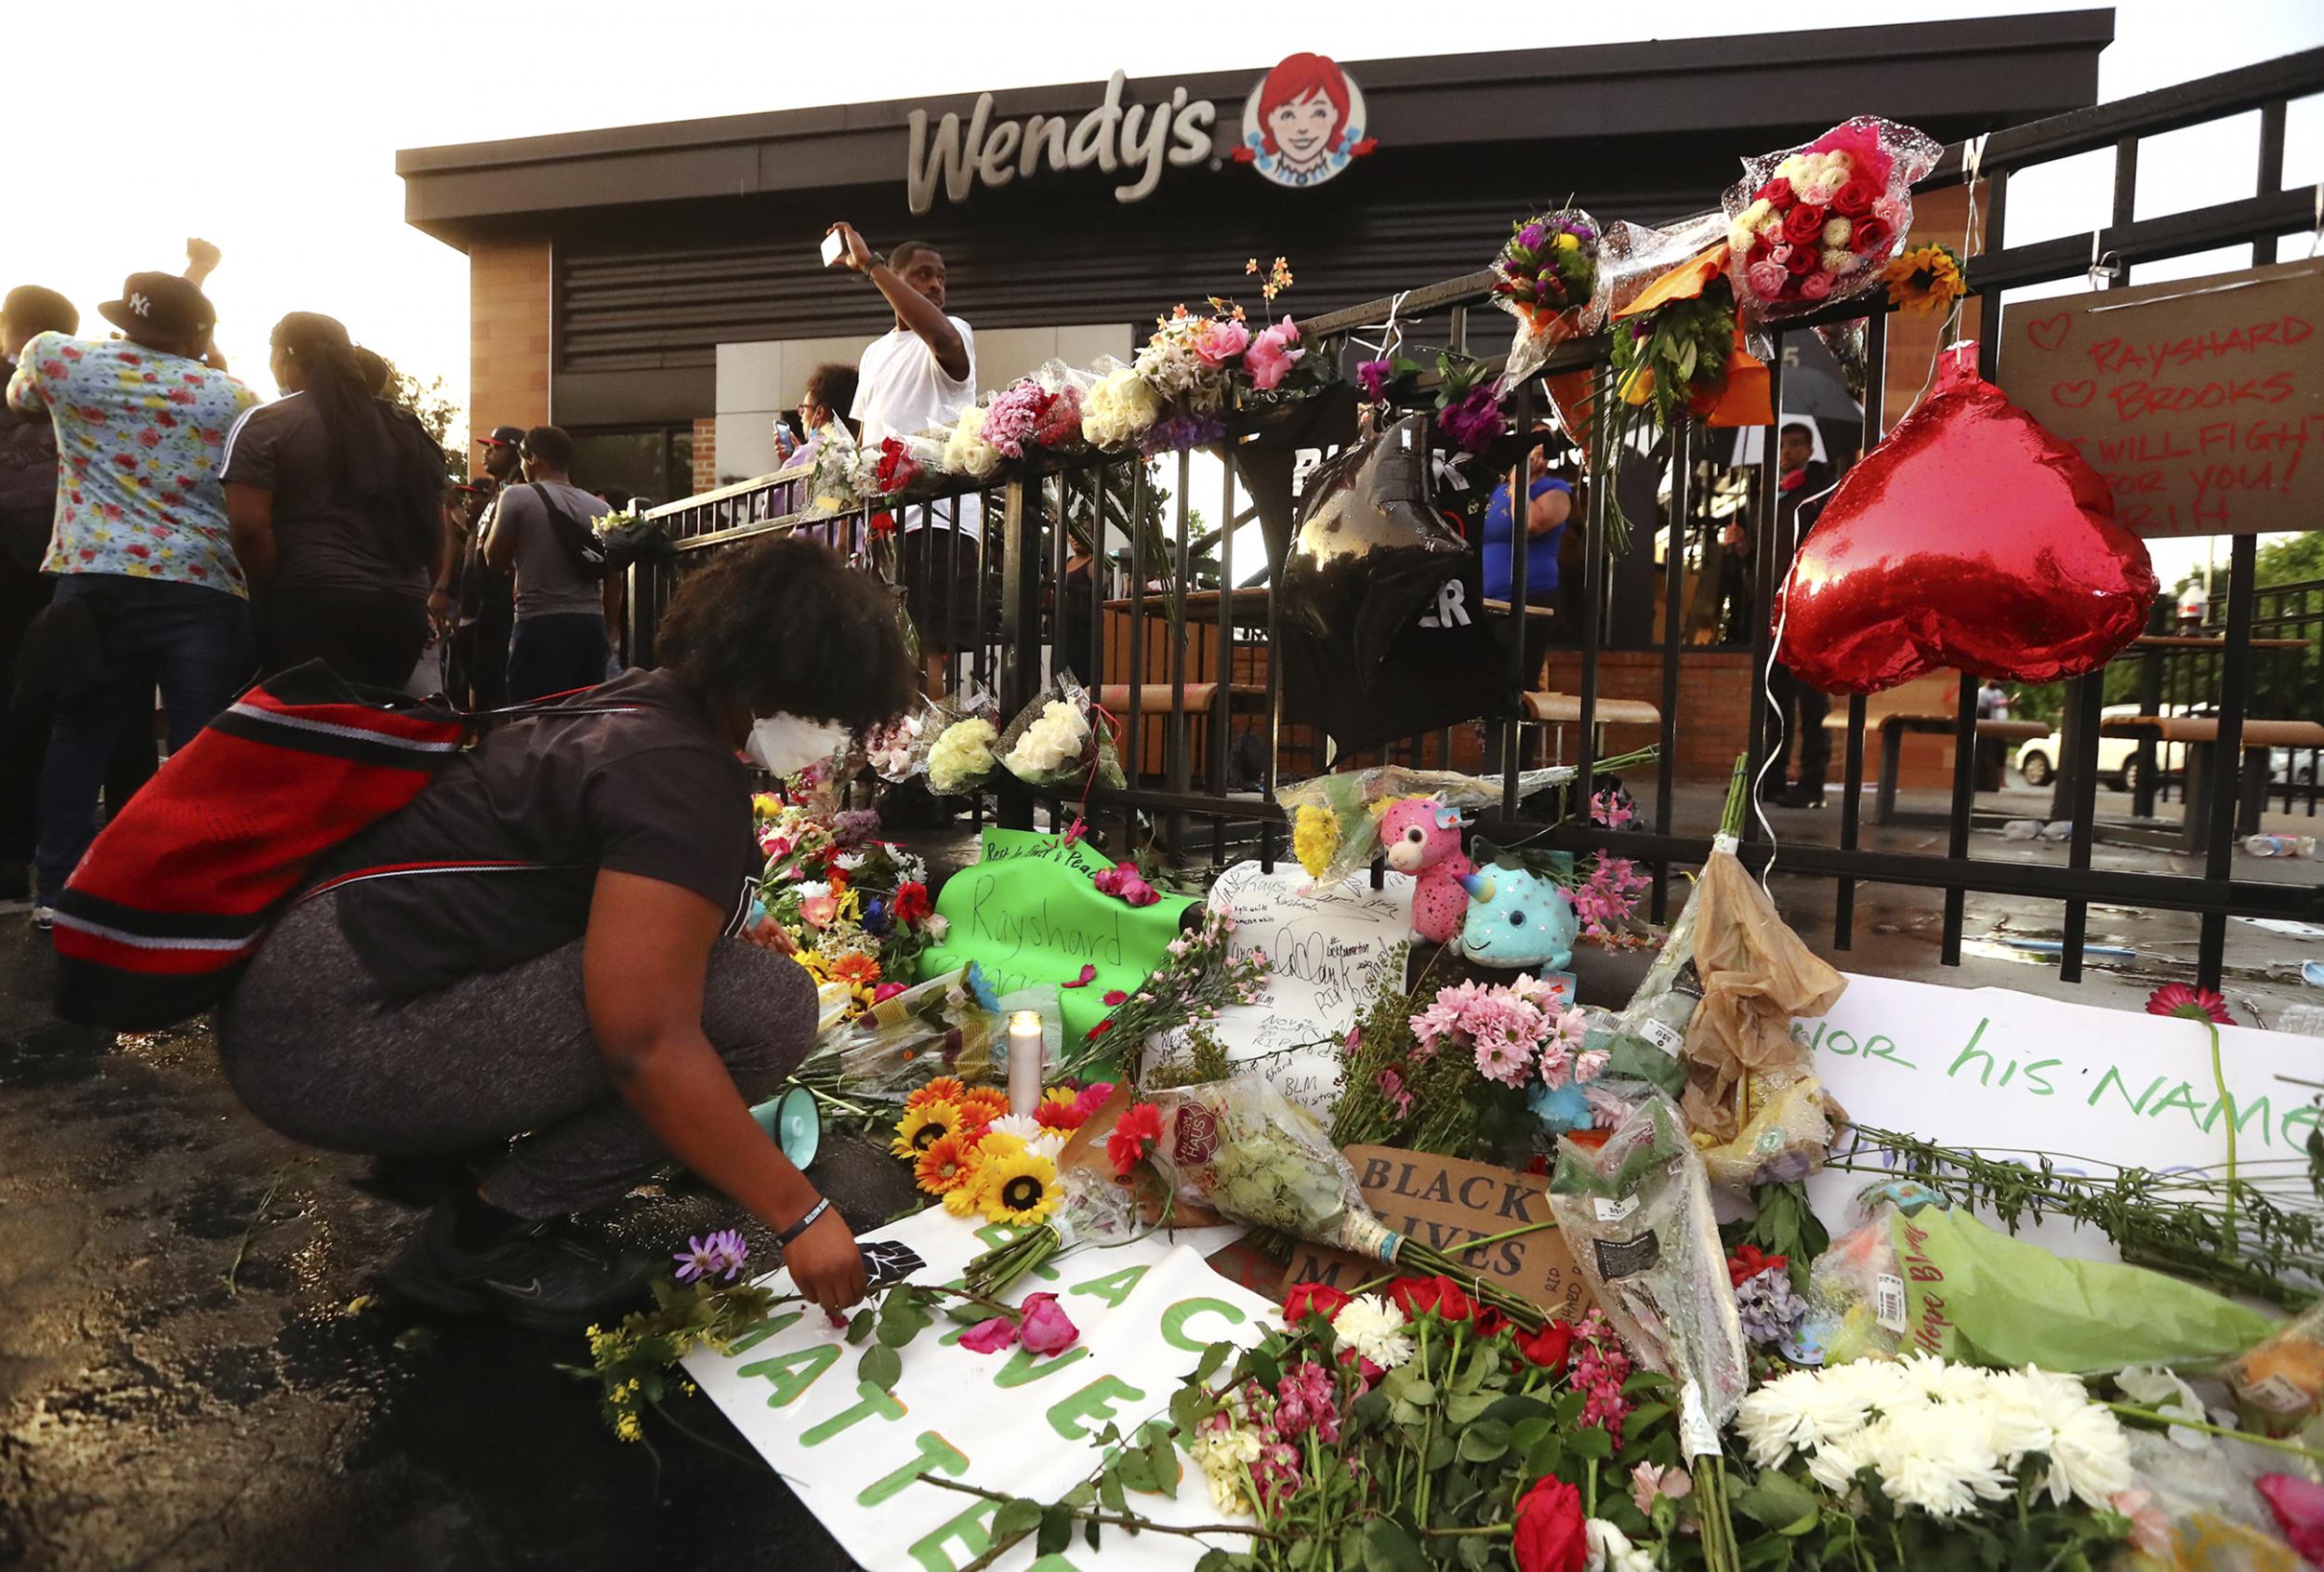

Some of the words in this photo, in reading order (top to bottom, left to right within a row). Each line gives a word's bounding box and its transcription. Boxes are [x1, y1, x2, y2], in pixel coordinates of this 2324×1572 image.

[906, 69, 1216, 216] Wendy's
[129, 292, 151, 317] NY
[2087, 315, 2314, 378] RAYSHARD
[2107, 373, 2297, 421] BROOKS
[2098, 431, 2192, 464] WILL
[1064, 851, 1095, 879] Peac
[971, 874, 1122, 967] Rayshard
[1285, 1076, 1318, 1097] BLM
[1187, 1118, 1206, 1157] HAUS
[1361, 1157, 1542, 1224] BLACK
[1545, 1267, 1561, 1293] RIP
[1913, 1290, 1954, 1355] Hope
